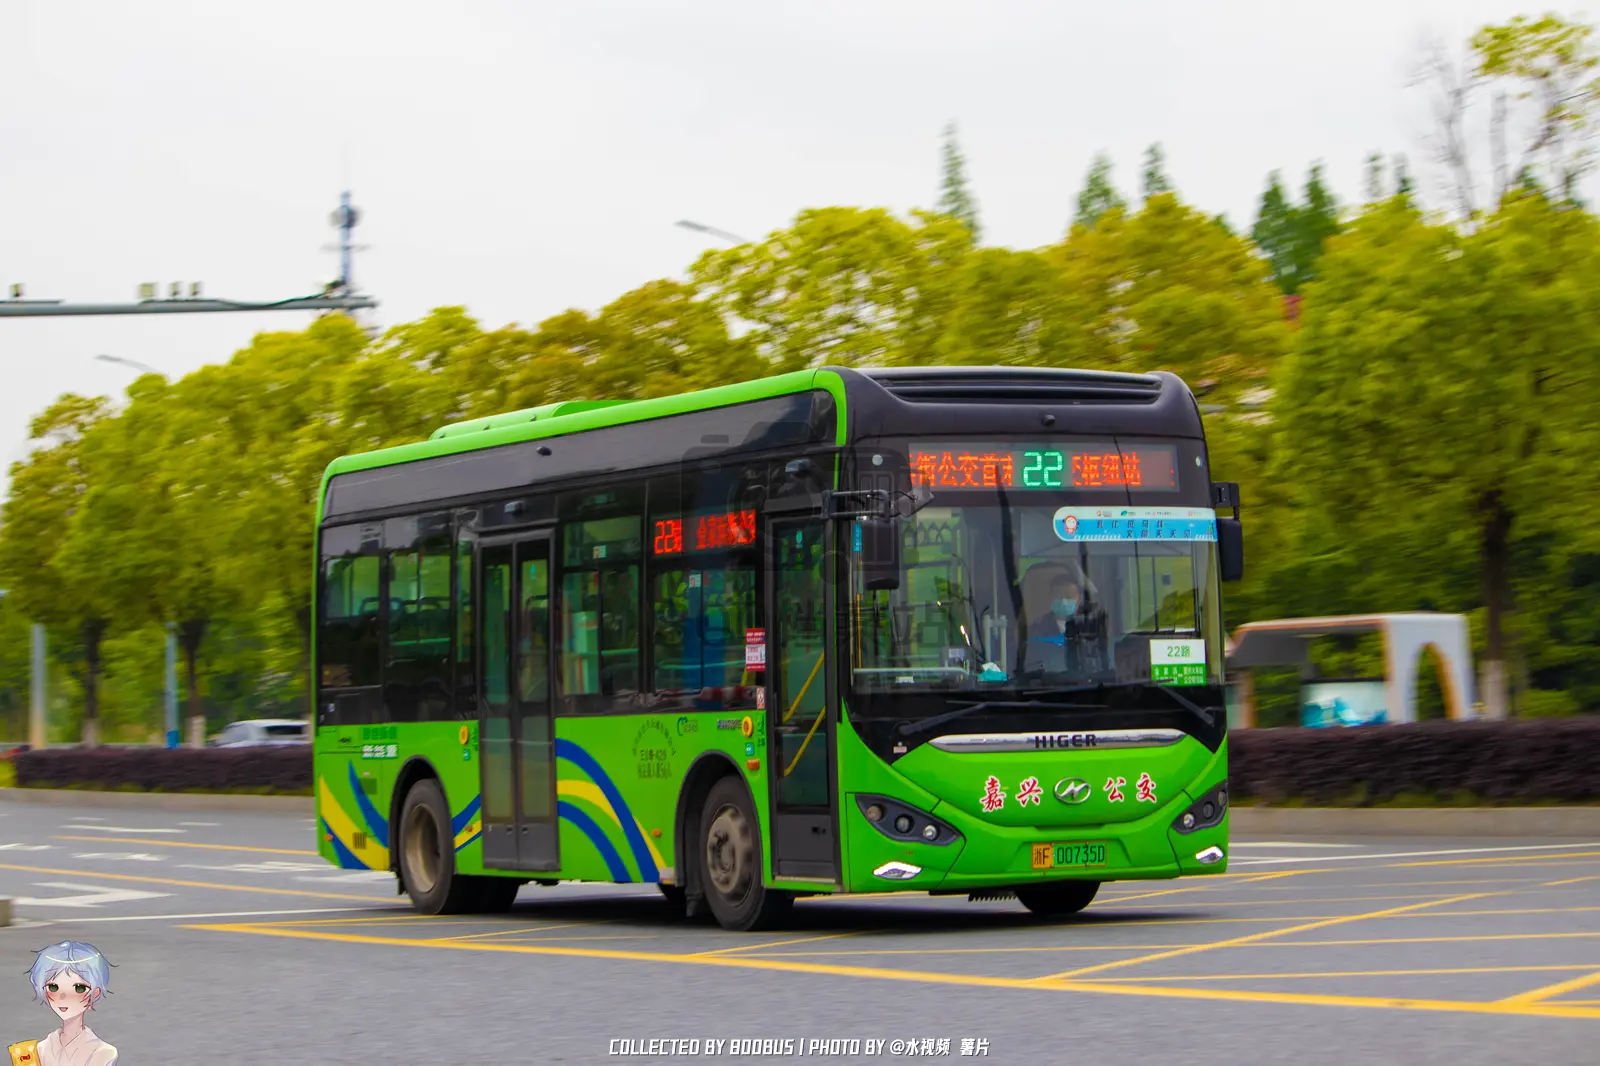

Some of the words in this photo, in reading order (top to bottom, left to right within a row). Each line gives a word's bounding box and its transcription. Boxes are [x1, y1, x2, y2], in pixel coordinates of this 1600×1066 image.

[1023, 451, 1063, 486] 22
[1167, 645, 1191, 657] 22路
[1035, 734, 1097, 749] HIGER
[980, 776, 1043, 812] 嘉兴
[1103, 772, 1157, 802] 公交
[1056, 844, 1105, 865] 00735D
